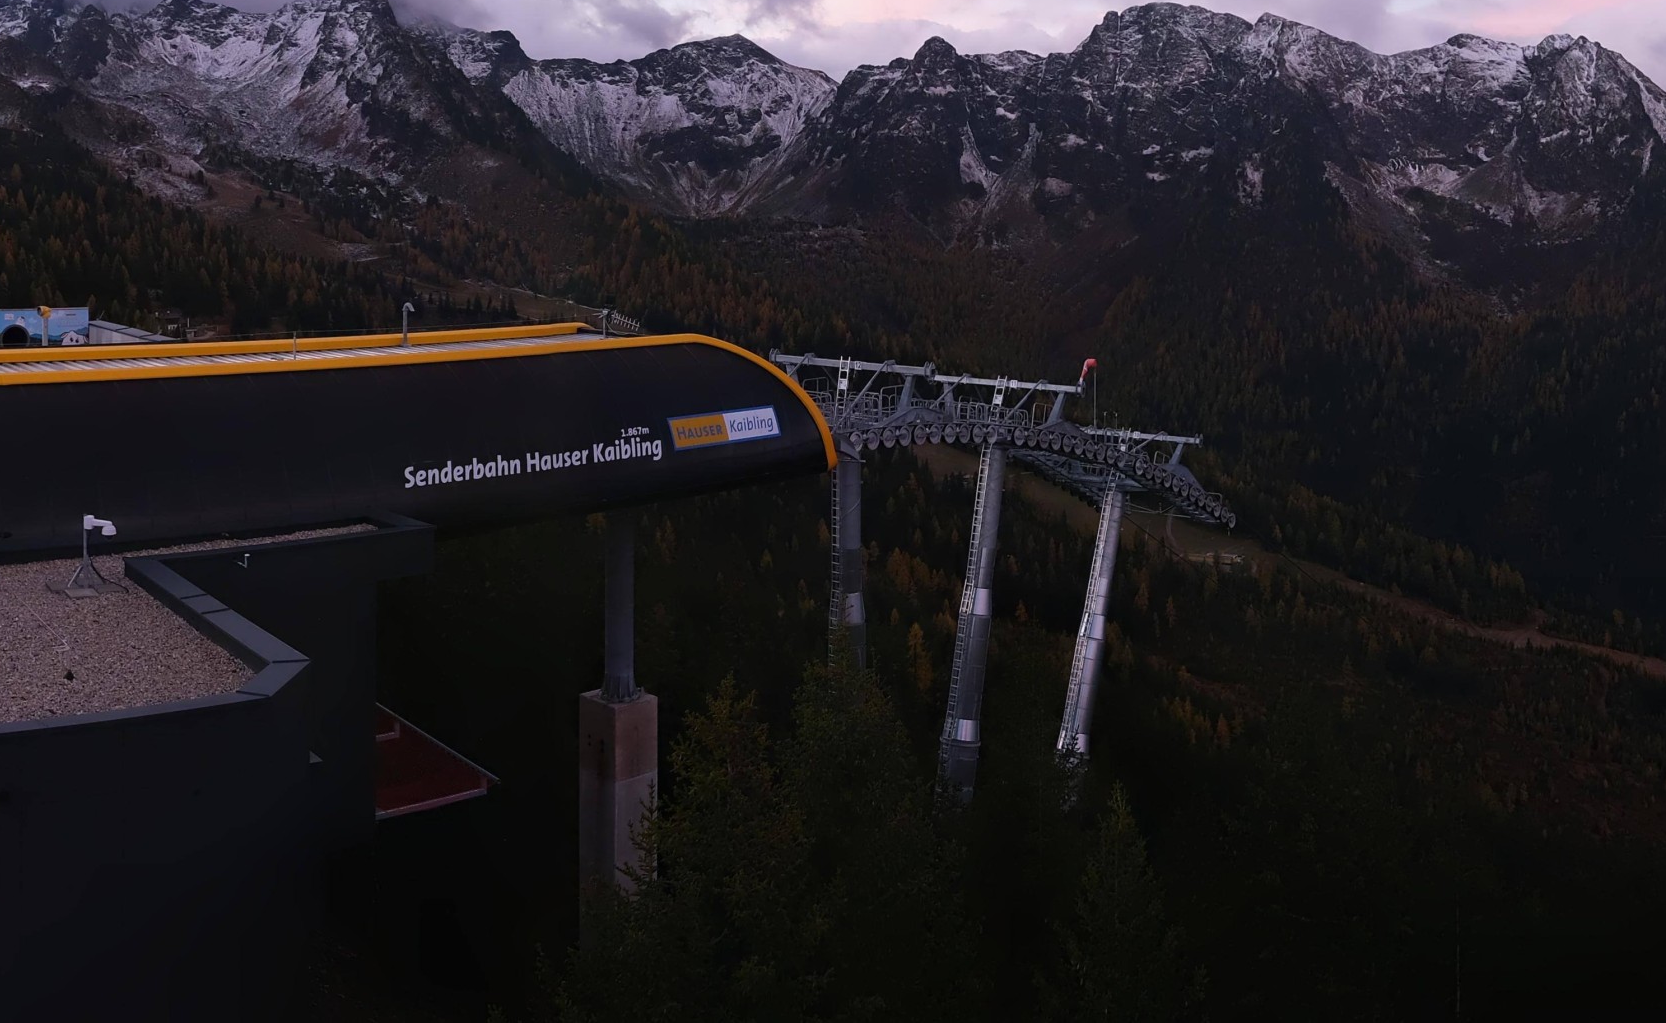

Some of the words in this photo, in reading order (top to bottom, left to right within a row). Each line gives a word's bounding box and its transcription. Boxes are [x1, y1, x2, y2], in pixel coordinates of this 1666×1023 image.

[621, 427, 650, 437] 1.867m
[676, 424, 723, 440] HAUSER
[729, 417, 774, 433] Kaibling
[404, 455, 521, 489] Senderbahn
[526, 447, 589, 473] Hauser
[593, 437, 663, 464] Kaibling
